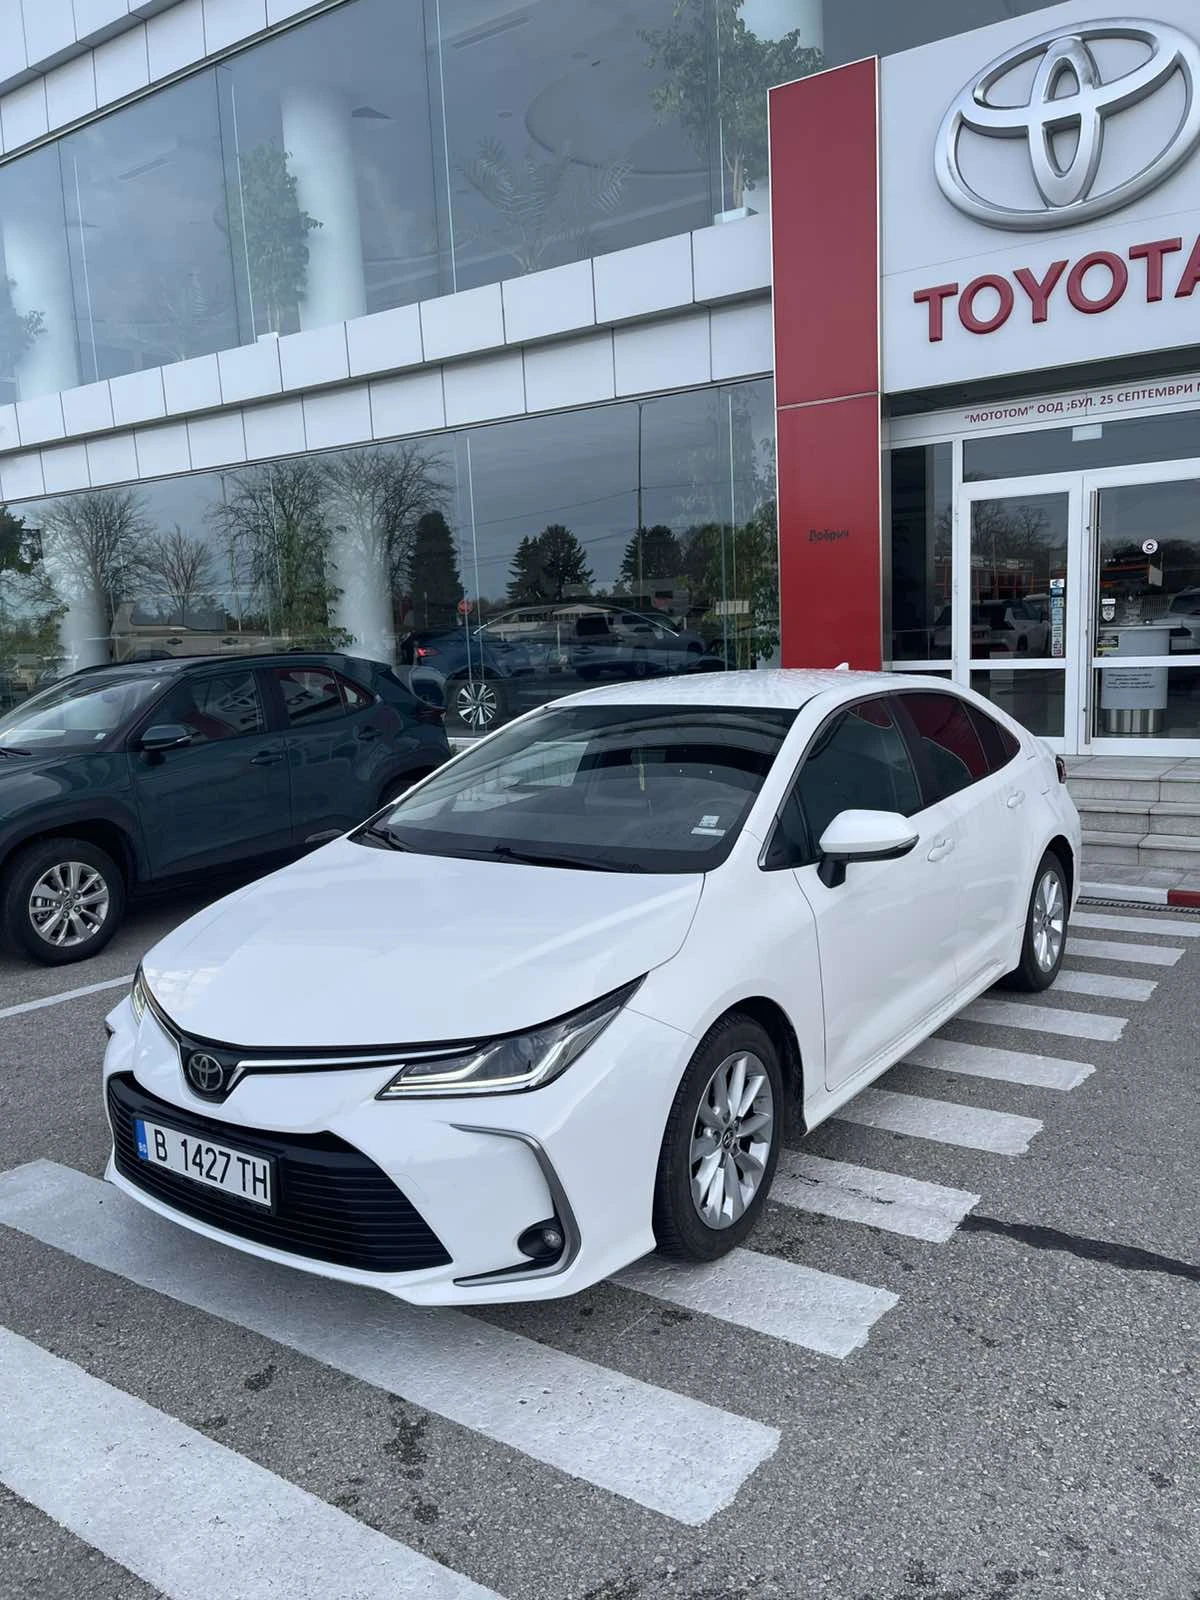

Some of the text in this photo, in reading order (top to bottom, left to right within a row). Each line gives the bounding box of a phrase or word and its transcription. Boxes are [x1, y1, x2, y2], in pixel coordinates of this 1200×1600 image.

[1037, 401, 1063, 414] ООД
[1066, 397, 1096, 411] ;БУЛ.
[1100, 394, 1114, 405] 25
[1116, 383, 1193, 403] СЕПТЕМВРИ
[154, 1129, 268, 1200] B 1427 TH
